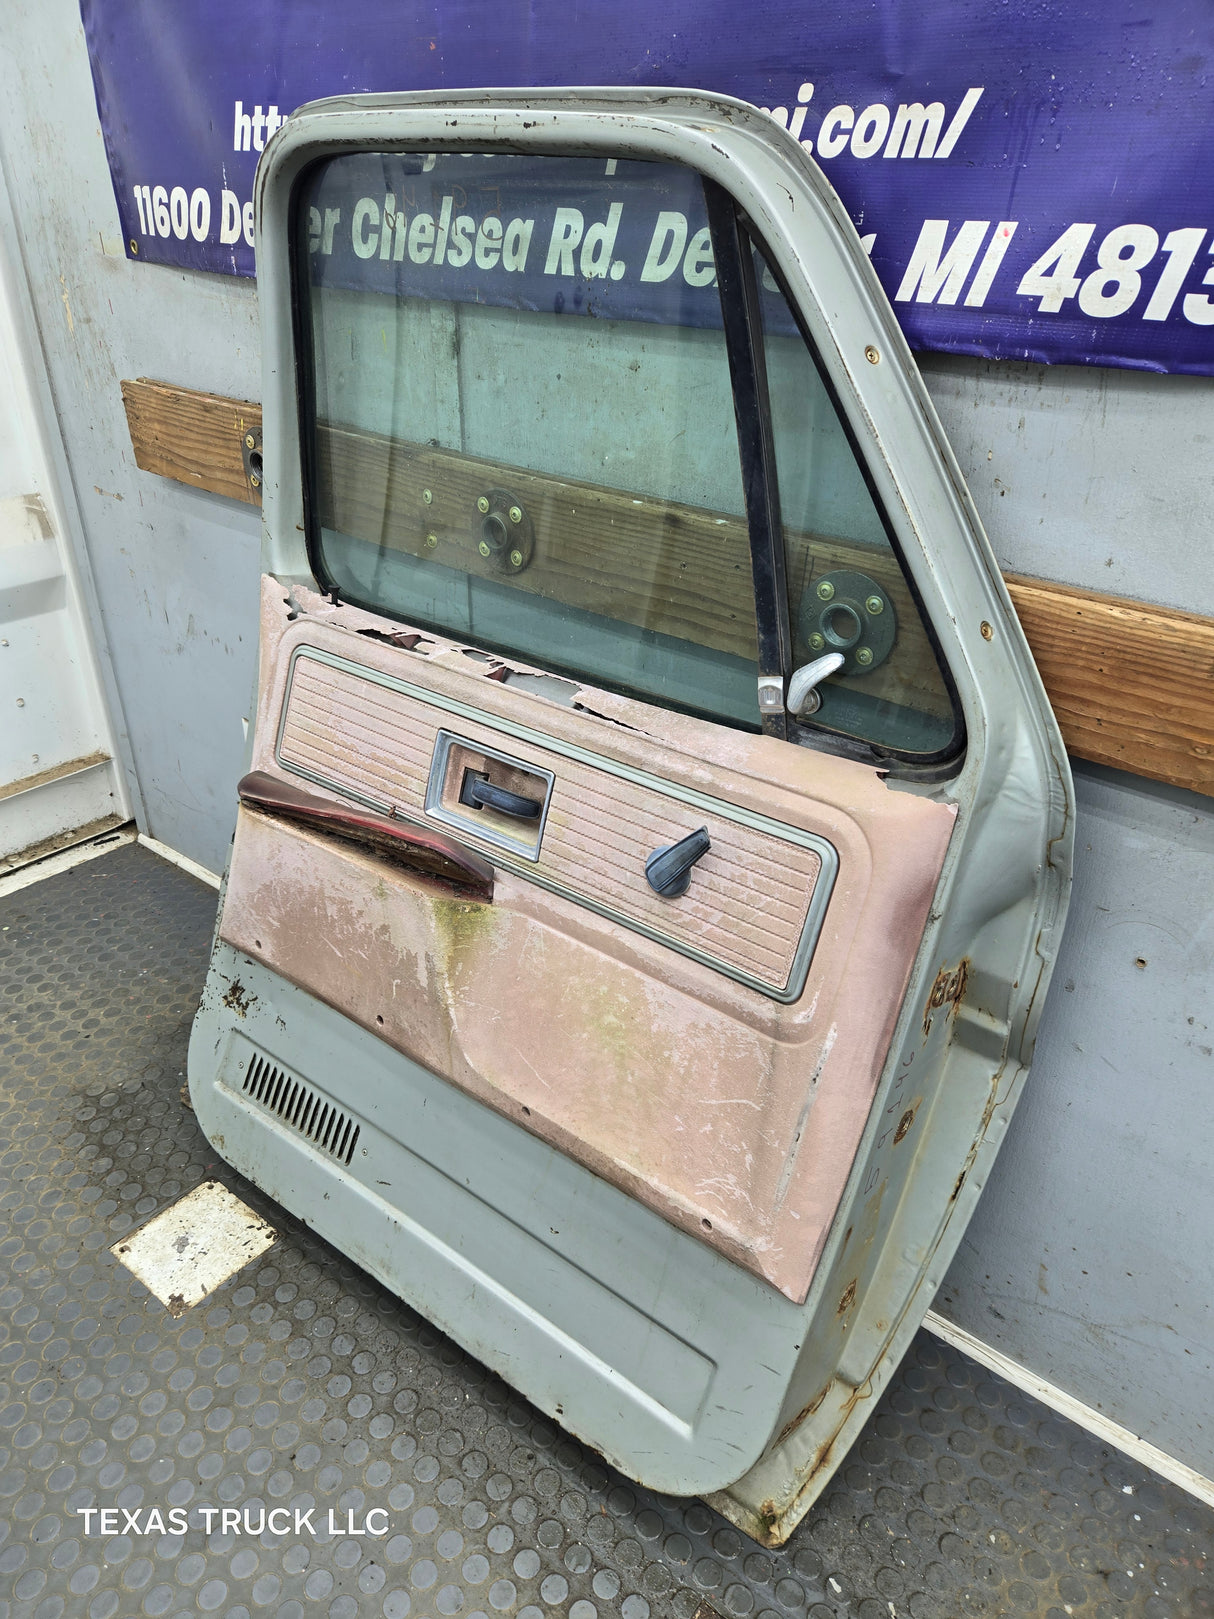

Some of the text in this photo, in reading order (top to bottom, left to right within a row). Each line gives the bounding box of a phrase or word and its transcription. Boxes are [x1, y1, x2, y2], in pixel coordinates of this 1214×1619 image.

[233, 101, 289, 151] htt
[134, 185, 211, 242] 11600
[351, 193, 535, 272] Chelsea
[544, 202, 626, 281] Rd.
[894, 219, 1019, 307] MI
